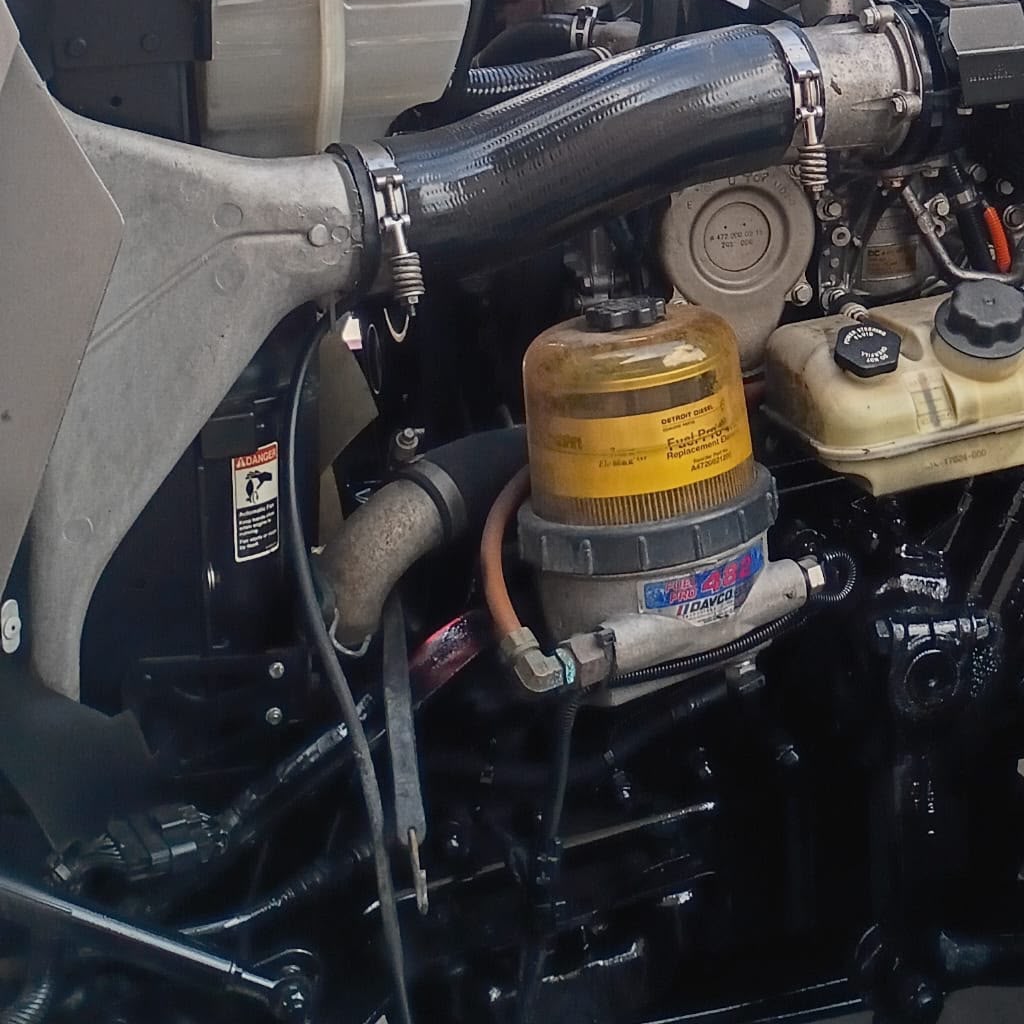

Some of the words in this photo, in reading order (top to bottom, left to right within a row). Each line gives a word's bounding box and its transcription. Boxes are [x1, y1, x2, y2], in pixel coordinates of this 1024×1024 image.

[661, 411, 692, 425] DETROIT
[246, 446, 277, 467] DANGER
[666, 438, 720, 461] Replacement
[668, 587, 697, 605] PRO
